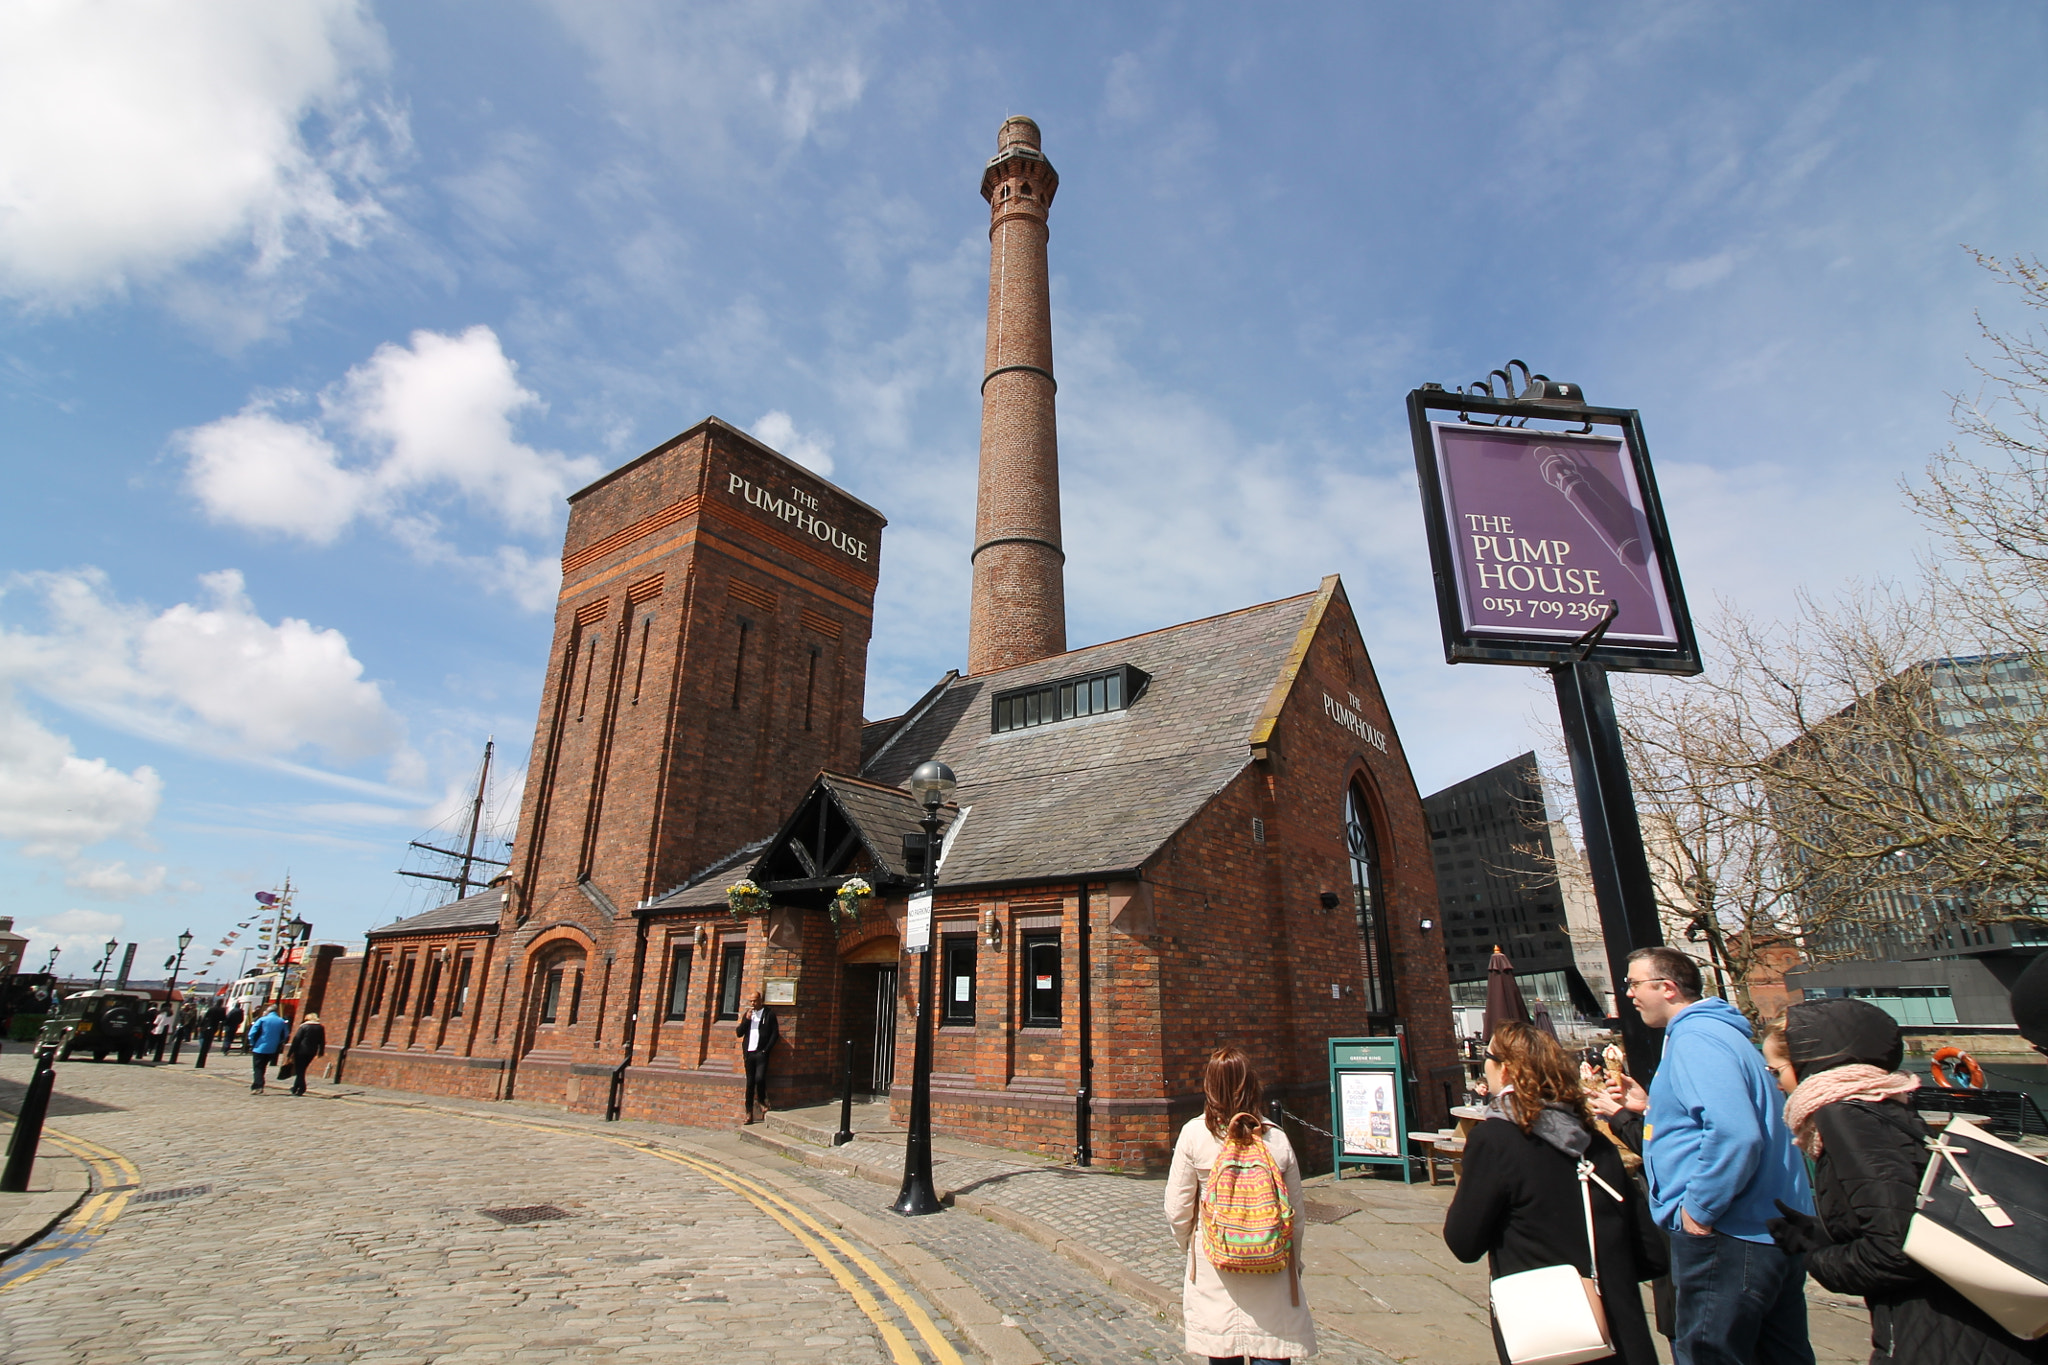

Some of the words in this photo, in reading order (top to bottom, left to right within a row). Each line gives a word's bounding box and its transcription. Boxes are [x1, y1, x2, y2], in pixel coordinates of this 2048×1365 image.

[791, 486, 819, 512] THE
[728, 472, 868, 562] PUMPHOUSE
[1465, 513, 1514, 534] THE
[1471, 534, 1571, 566] PUMP
[1476, 563, 1605, 596] HOUSE
[1482, 597, 1524, 617] 0151
[1527, 600, 1564, 620] 709
[1567, 599, 1610, 622] 2367
[1347, 691, 1362, 712] THE
[1323, 692, 1388, 755] PUMPHOUSE
